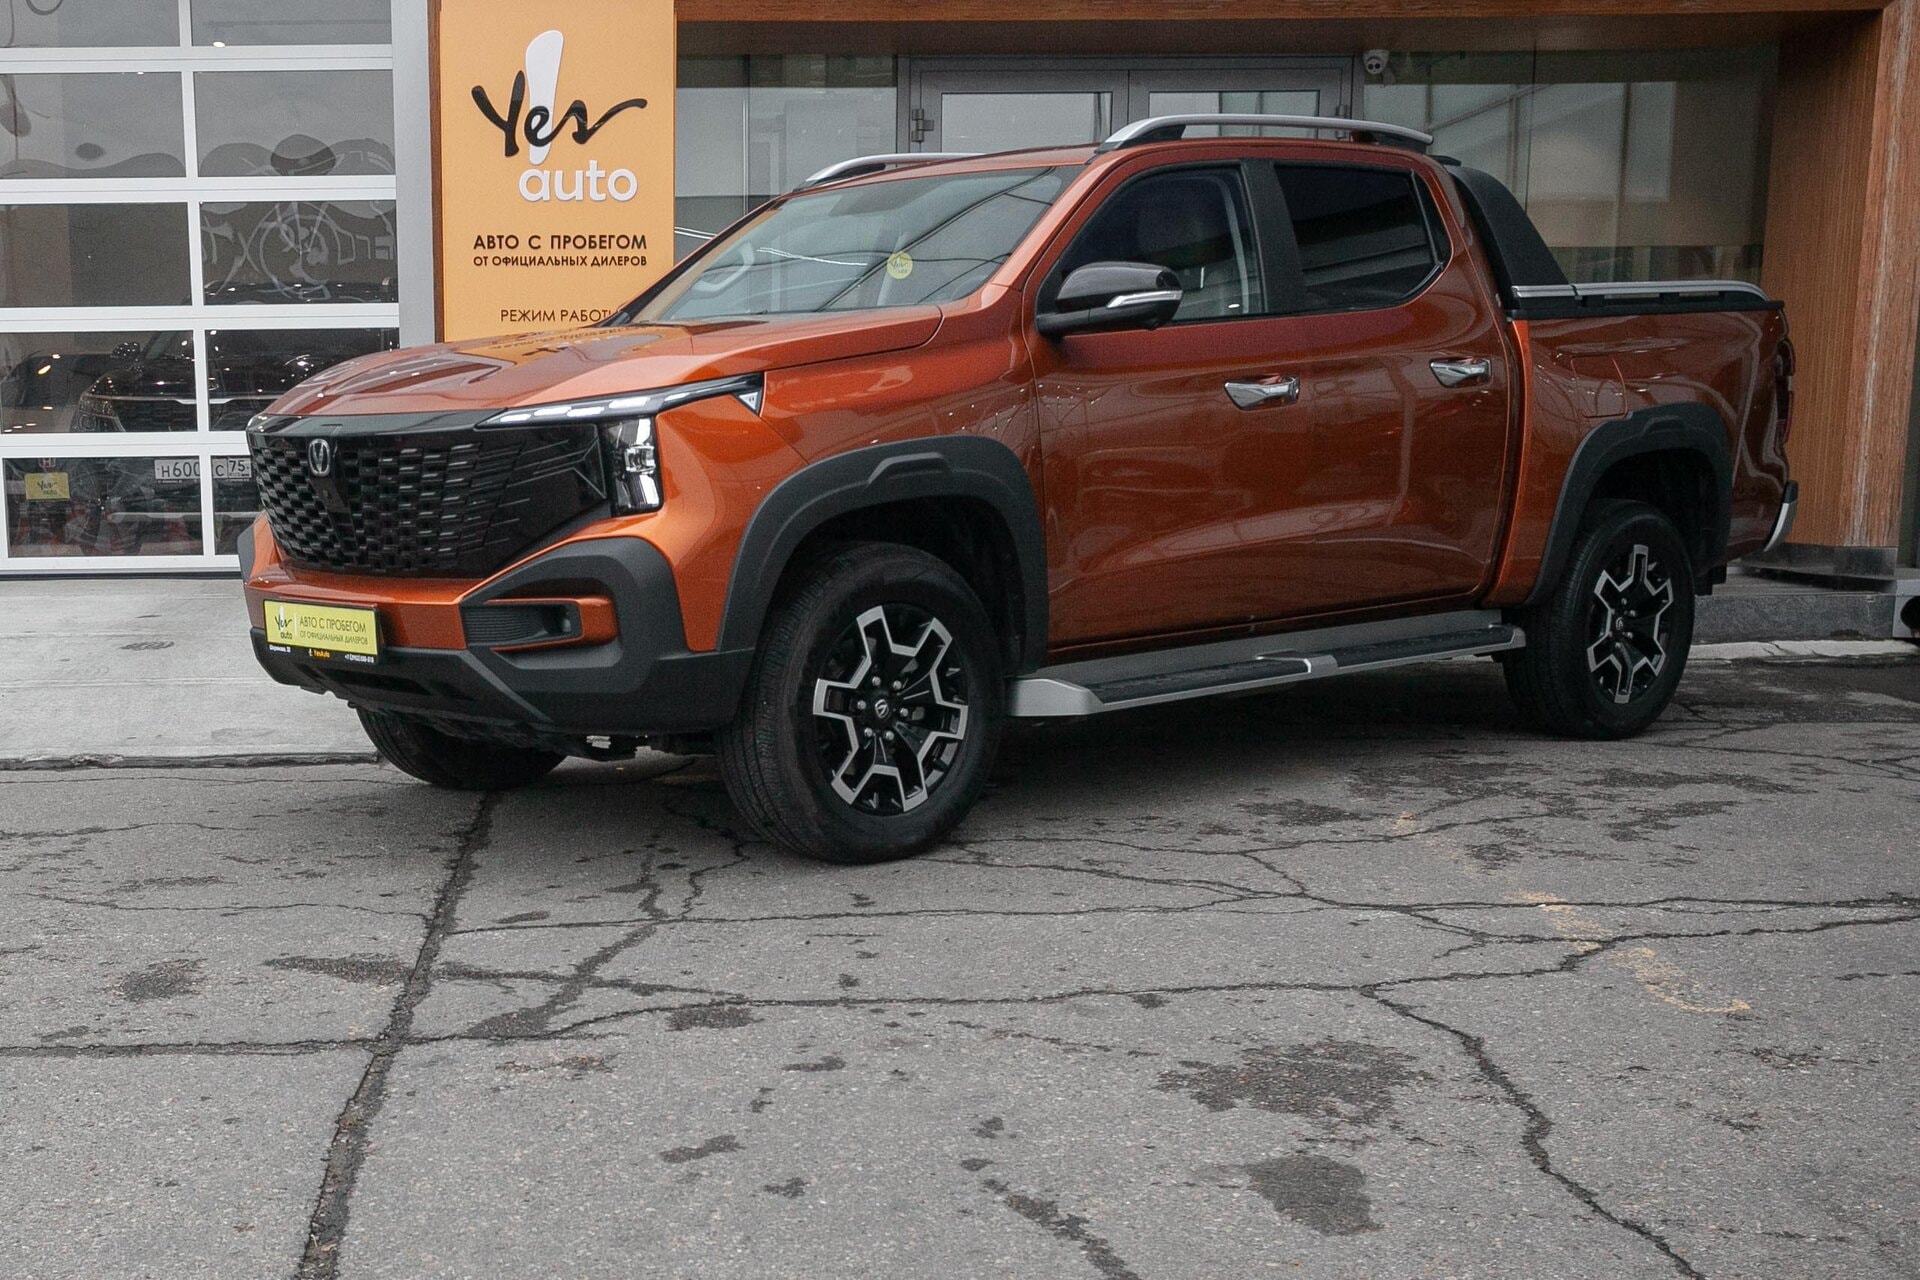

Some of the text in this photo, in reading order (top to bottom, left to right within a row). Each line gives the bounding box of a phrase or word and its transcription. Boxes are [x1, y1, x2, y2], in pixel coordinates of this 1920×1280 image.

[471, 70, 648, 158] Yes
[518, 159, 638, 202] auto
[473, 234, 647, 250] АВТО С ПРОБЕГОМ
[473, 255, 647, 268] ОТ ОФИЦИАЛЬНЫХ ДИЛЕРОВ
[500, 309, 612, 323] РЕЖИМ РАБОТ
[274, 613, 293, 631] Yes
[299, 616, 317, 629] АВТО
[326, 619, 366, 633] ПРОБЕГОМ
[280, 631, 293, 640] auto
